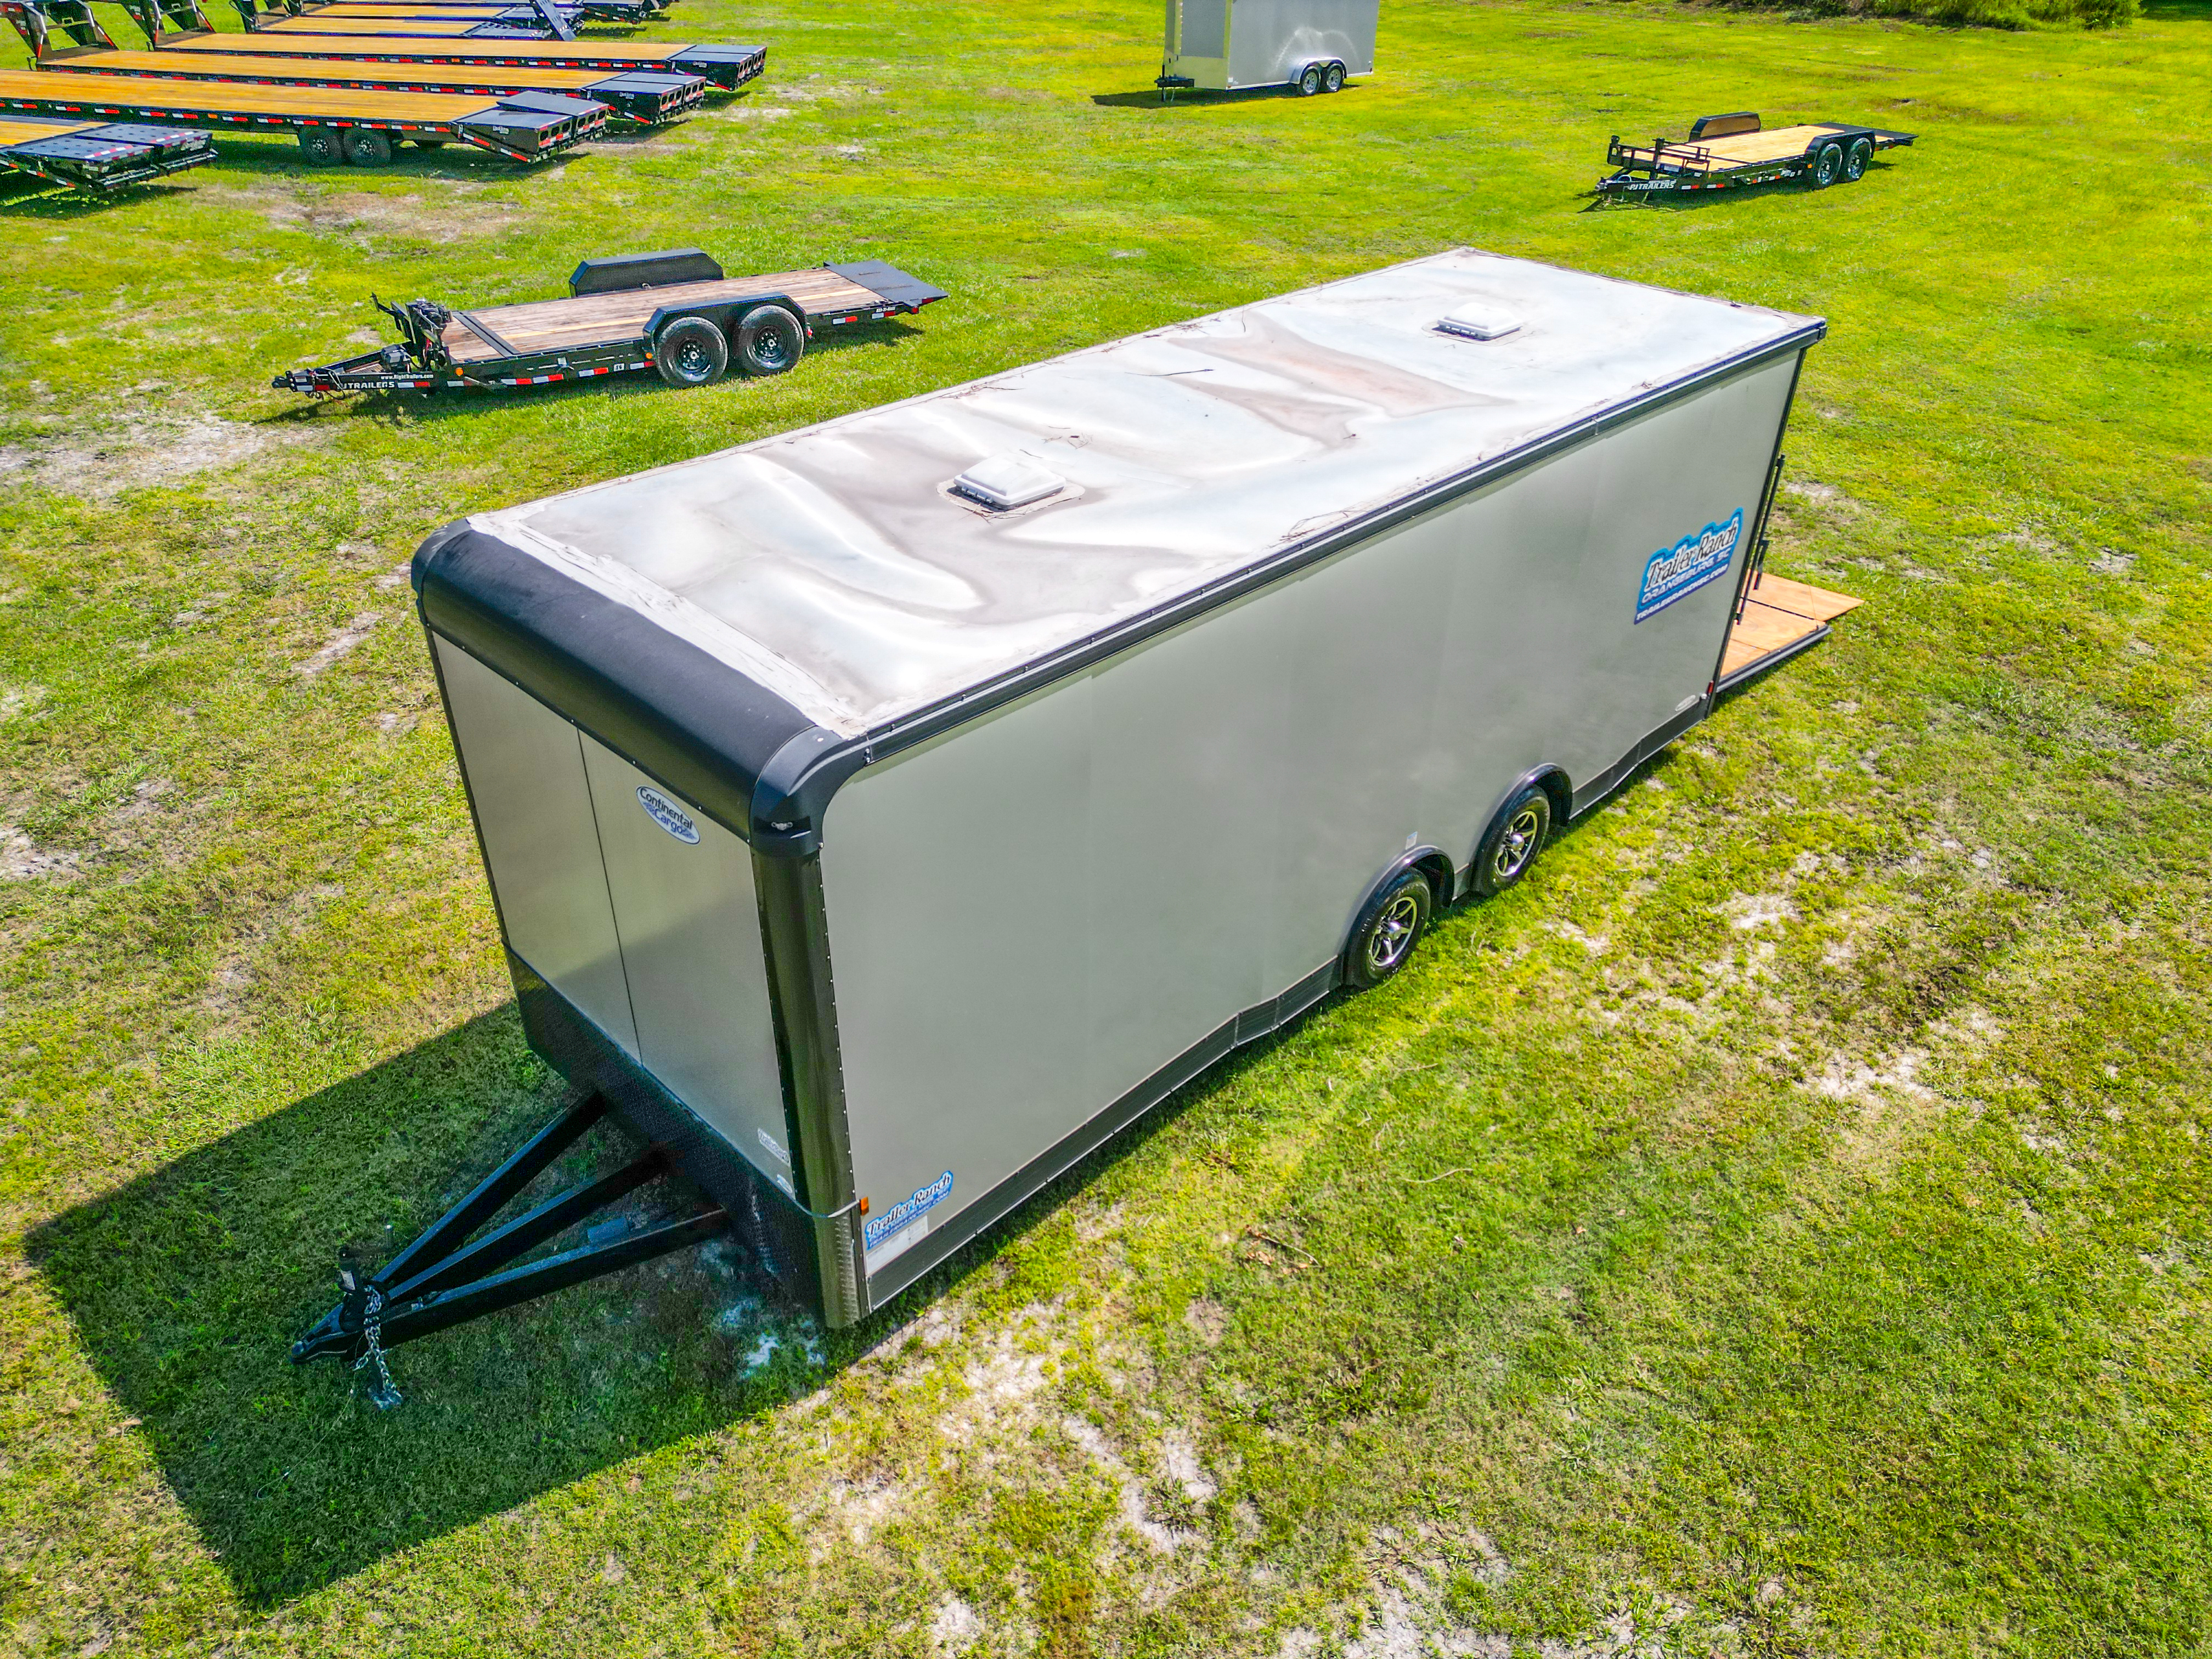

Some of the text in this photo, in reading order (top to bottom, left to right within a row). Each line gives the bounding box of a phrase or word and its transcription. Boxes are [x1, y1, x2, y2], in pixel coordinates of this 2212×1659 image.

[1639, 180, 1675, 190] TRAILERS
[1641, 548, 1731, 603] ORANGEBURG SC
[1645, 517, 1738, 591] Trailer Ranch
[640, 787, 692, 830] Continental
[654, 808, 684, 834] Cargo
[868, 1201, 912, 1235] Trailer
[914, 1174, 950, 1205] Ranch
